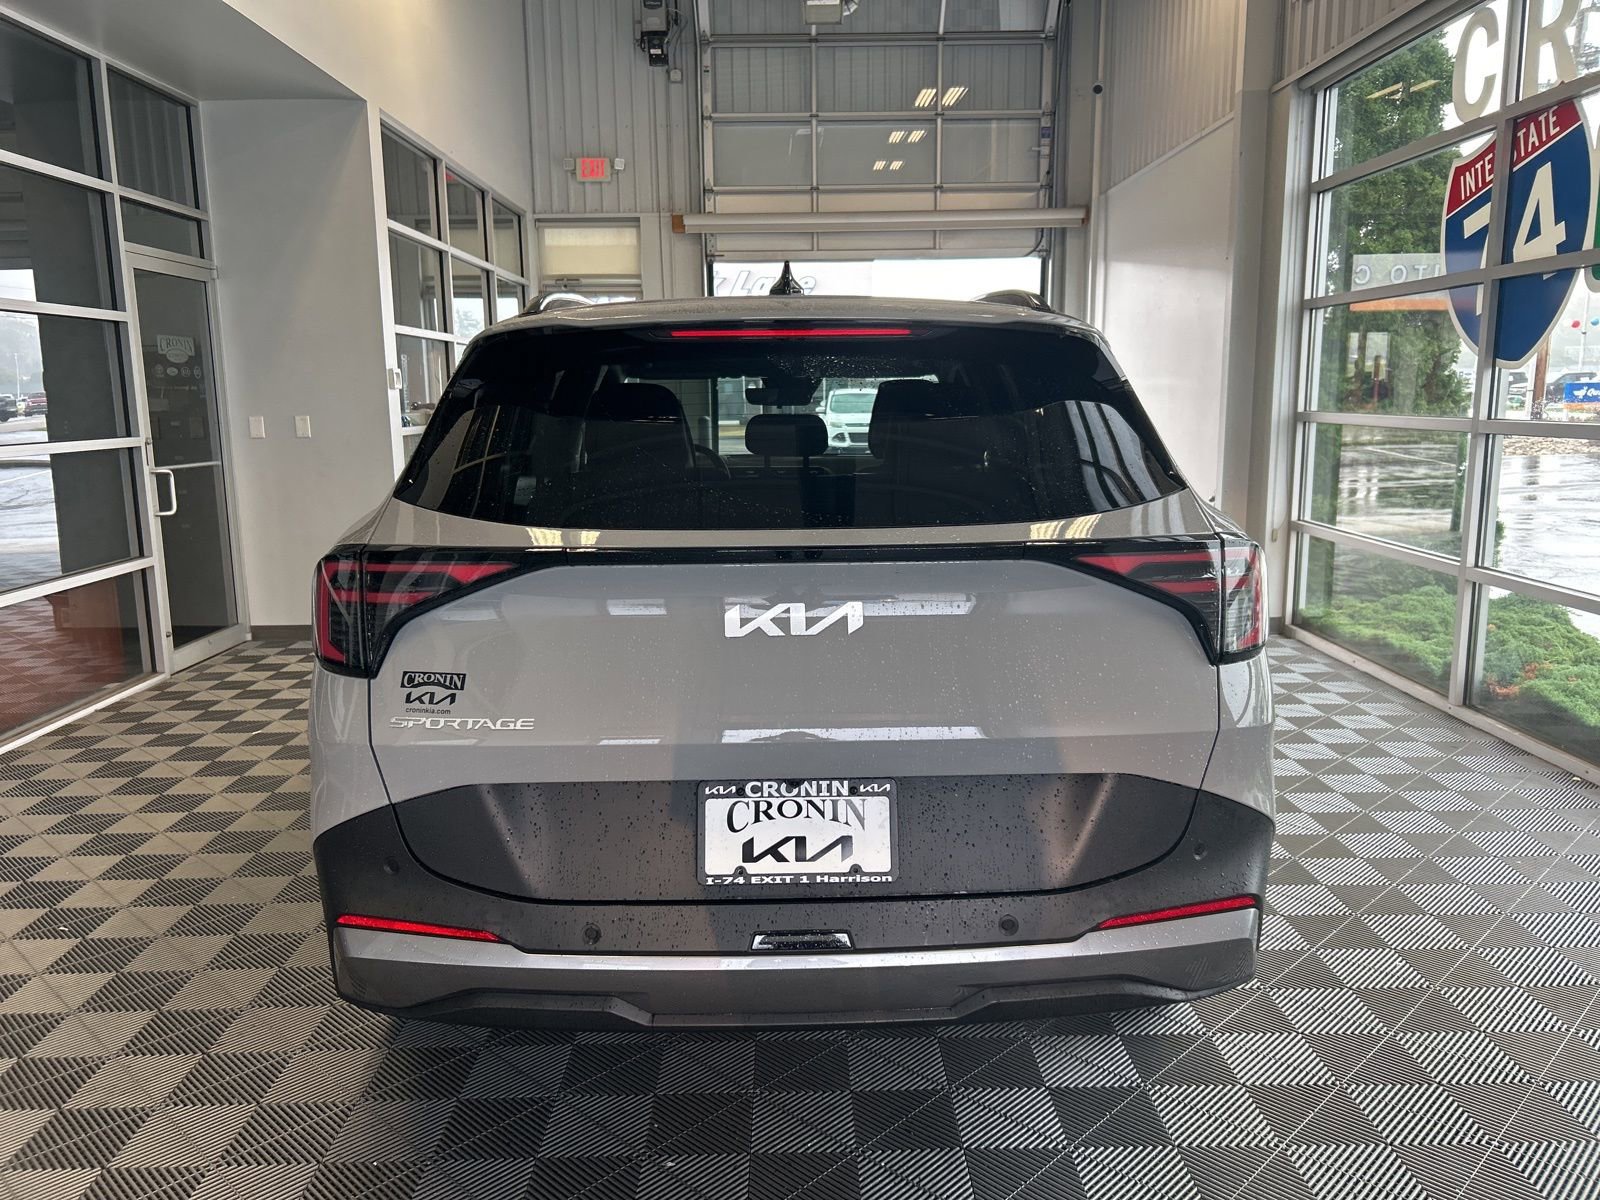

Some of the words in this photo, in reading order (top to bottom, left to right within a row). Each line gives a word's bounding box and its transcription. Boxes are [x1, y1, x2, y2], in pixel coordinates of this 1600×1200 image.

[1460, 106, 1561, 201] INTETATE
[581, 159, 605, 177] EXIT
[159, 336, 194, 354] CRONIN
[724, 601, 864, 637] KIA
[403, 672, 464, 690] CRONIN
[405, 691, 457, 706] KIA
[405, 706, 451, 715] croninkia.com
[389, 716, 536, 730] SPORTAGE
[705, 783, 737, 795] KIA
[745, 780, 849, 797] CRONIN
[860, 783, 891, 793] KIA
[726, 799, 867, 834] CRONIN
[742, 835, 854, 863] KIA
[705, 876, 746, 886] I-74
[751, 875, 794, 885] EXIT
[799, 875, 810, 884] 1
[816, 874, 893, 884] Harrison
